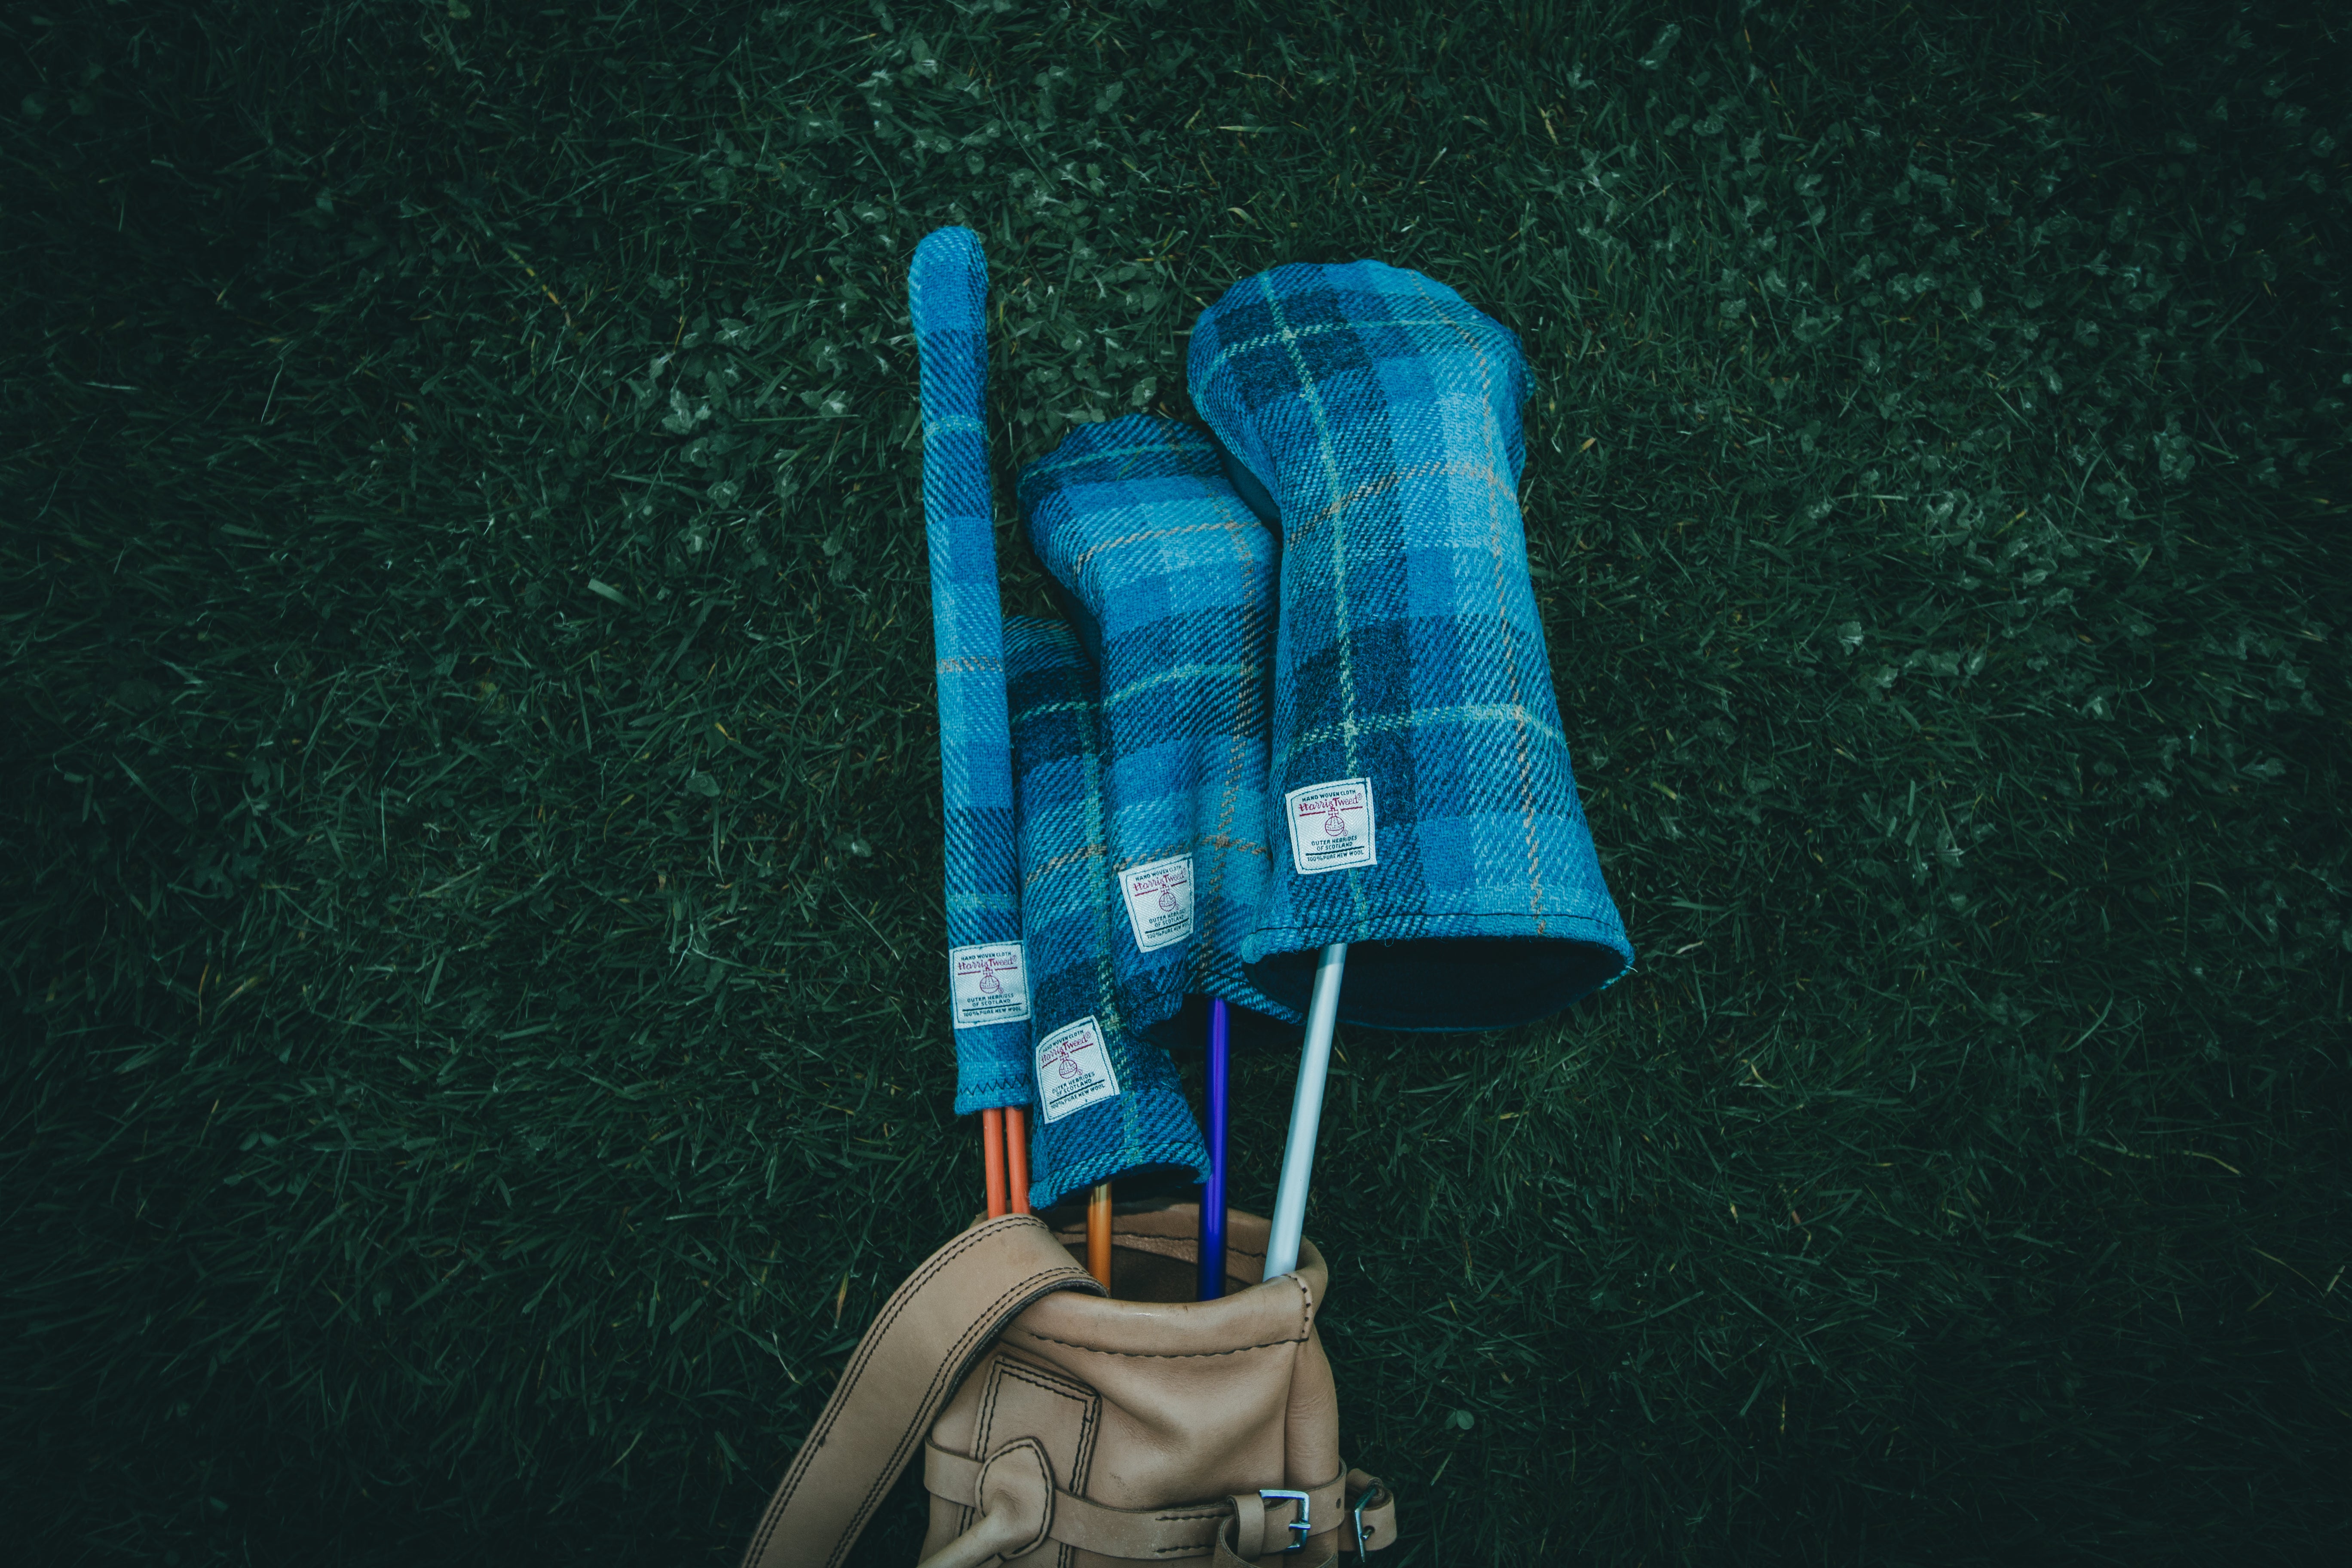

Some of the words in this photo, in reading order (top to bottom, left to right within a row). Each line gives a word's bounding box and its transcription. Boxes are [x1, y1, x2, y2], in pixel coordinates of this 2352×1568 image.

[1298, 799, 1332, 812] Harris
[1326, 842, 1352, 850] SCOTLAND
[1152, 868, 1168, 876] WOVEN
[1133, 877, 1164, 891] Harris
[1168, 909, 1186, 918] HEBRIDES
[1162, 916, 1183, 925] SCOTLAND
[959, 960, 988, 970] Harris
[1053, 1036, 1068, 1046] WOVEN
[1069, 1030, 1084, 1039] CLOTH
[1041, 1046, 1063, 1063] Harris
[1052, 1084, 1067, 1093] OUTER
[1069, 1072, 1095, 1085] HEBRIDES
[1063, 1079, 1092, 1093] SCOTLAND
[1065, 1094, 1078, 1103] PURE
